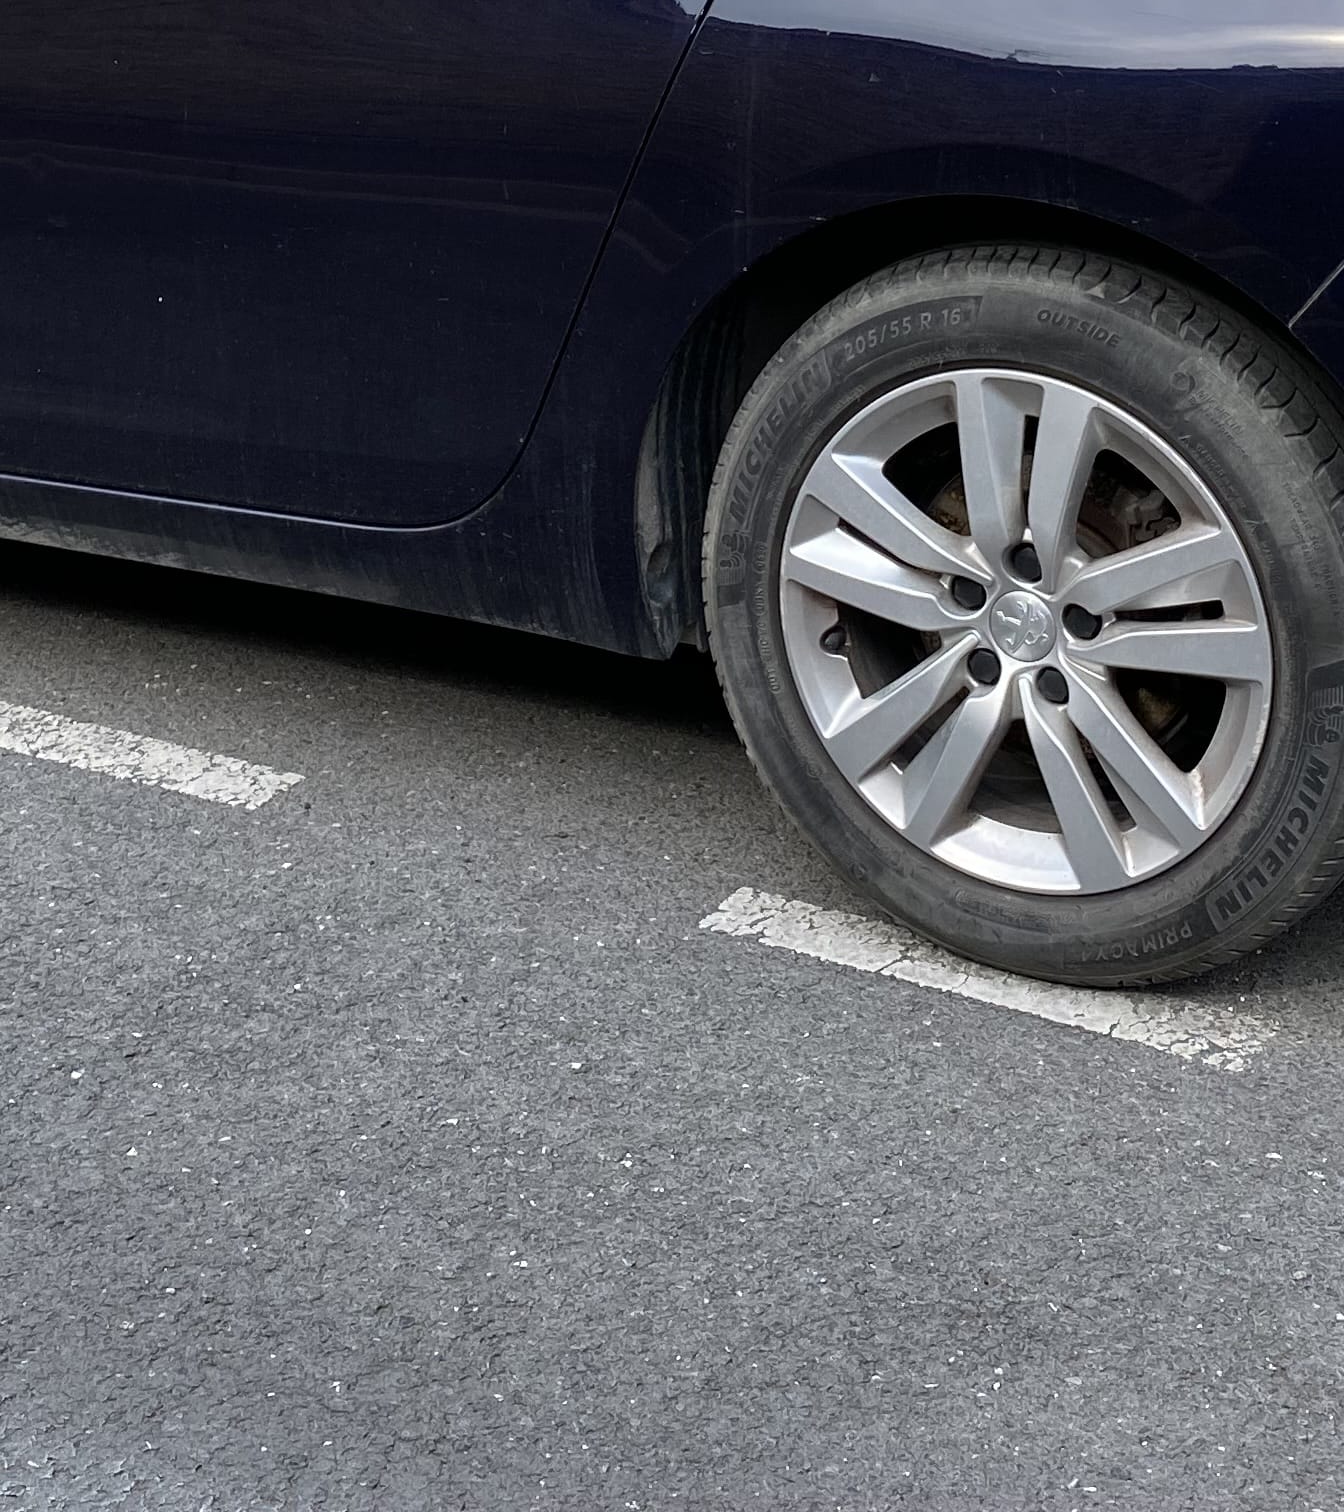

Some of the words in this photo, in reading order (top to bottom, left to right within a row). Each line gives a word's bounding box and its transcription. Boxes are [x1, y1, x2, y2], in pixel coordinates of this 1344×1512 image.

[1037, 309, 1121, 348] OUTSIDE
[729, 357, 830, 523] MICHELIN
[843, 317, 912, 362] 205/55
[919, 311, 932, 330] R
[941, 308, 962, 326] 16
[1217, 754, 1331, 922] MICHELIN
[1095, 920, 1193, 961] PRIMACY
